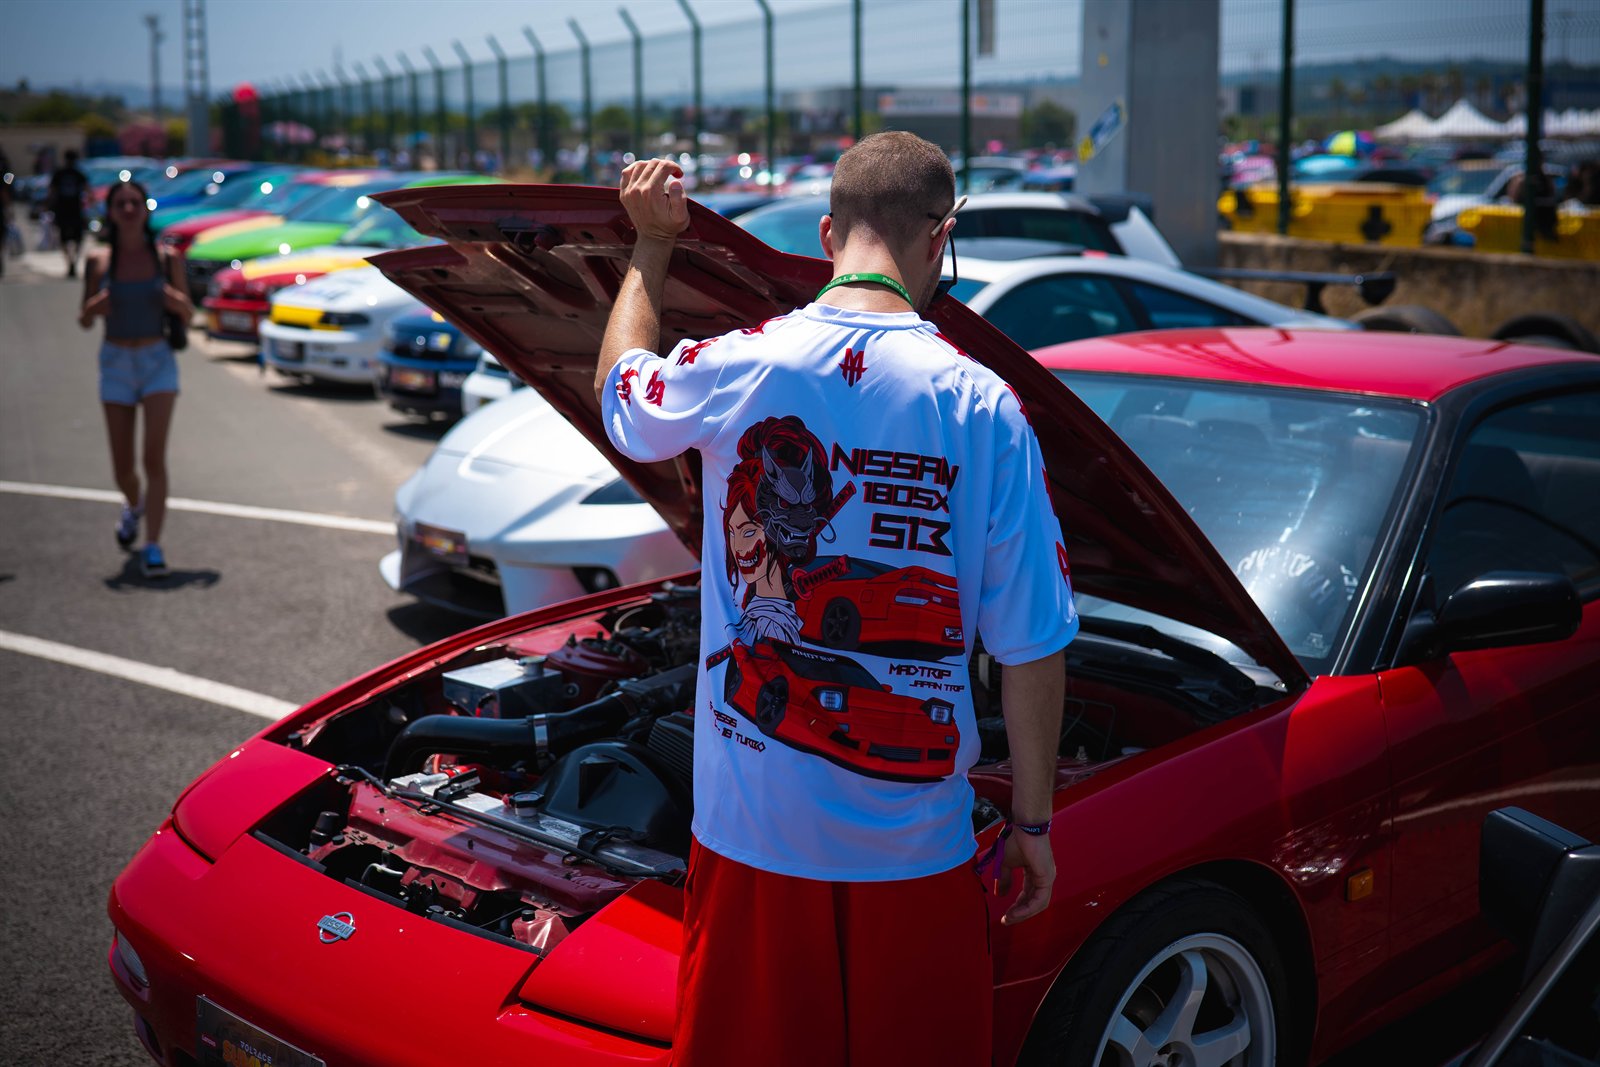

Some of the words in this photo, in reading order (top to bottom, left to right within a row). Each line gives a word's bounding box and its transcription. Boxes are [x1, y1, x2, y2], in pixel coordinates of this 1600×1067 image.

[830, 441, 960, 492] NISSAN
[862, 481, 950, 514] 180SX
[868, 512, 953, 557] S13
[888, 663, 952, 680] MADTRIP
[908, 680, 943, 691] JAPAN
[944, 684, 965, 693] TRIP
[735, 732, 766, 753] TURBO
[319, 915, 352, 937] NISSAN
